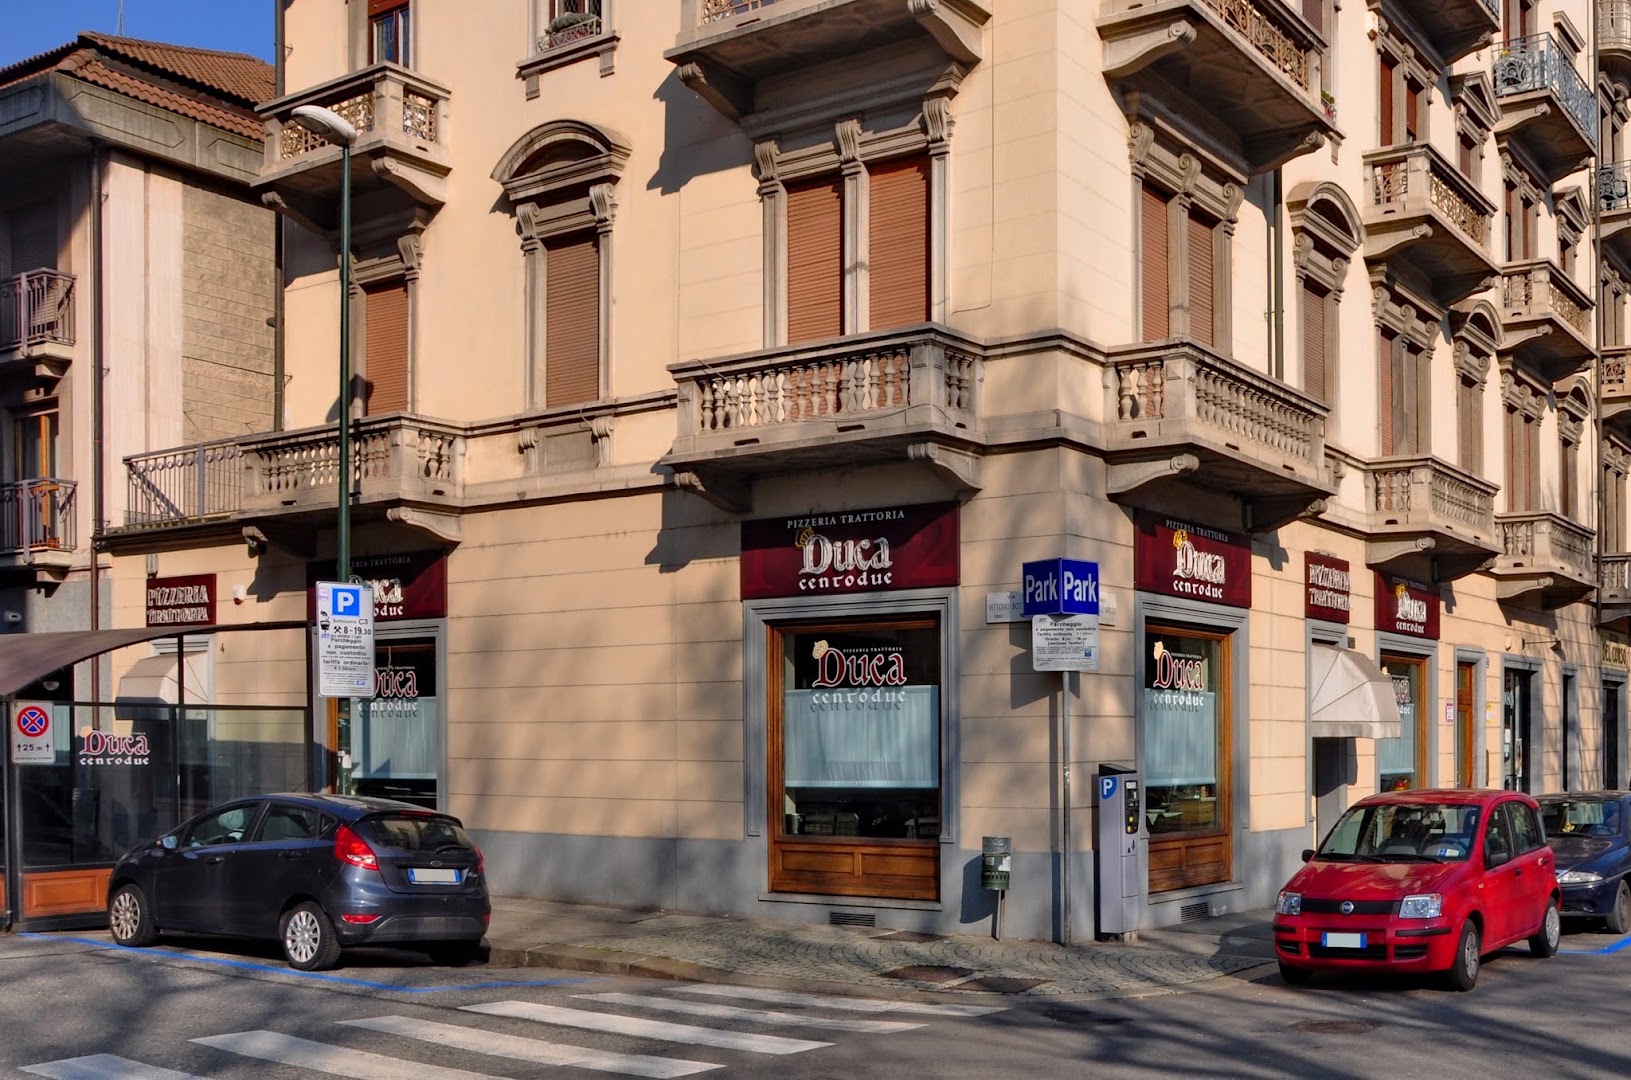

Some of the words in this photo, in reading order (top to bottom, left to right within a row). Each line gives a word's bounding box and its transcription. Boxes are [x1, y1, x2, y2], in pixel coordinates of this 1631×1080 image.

[787, 518, 837, 529] PIZZERIA
[840, 510, 905, 524] TRATTORIA
[1166, 520, 1195, 534] PIZZERIA
[1196, 527, 1229, 542] TRATTORIA
[351, 560, 368, 568] ERIA
[371, 555, 411, 567] TRATTORIA
[798, 533, 893, 575] Duca
[1173, 540, 1226, 584] Duca
[349, 575, 404, 604] uca
[1025, 572, 1059, 603] Park
[1063, 571, 1098, 603] Park
[1308, 564, 1349, 592] PIZZERIA
[147, 585, 209, 607] PIZZERIA
[337, 591, 355, 613] P
[988, 603, 1010, 612] VITTORIO
[1012, 602, 1022, 611] BOT
[1308, 587, 1351, 611] TRATTORIA
[1396, 591, 1427, 622] Duca
[147, 606, 209, 624] TRATTORIA
[374, 605, 404, 617] odue
[1602, 643, 1611, 662] DEL
[812, 647, 907, 688] Duca
[1153, 649, 1204, 691] Duca
[375, 669, 419, 697] uca
[23, 743, 35, 751] 25
[79, 730, 150, 755] Duca
[1103, 778, 1113, 796] P
